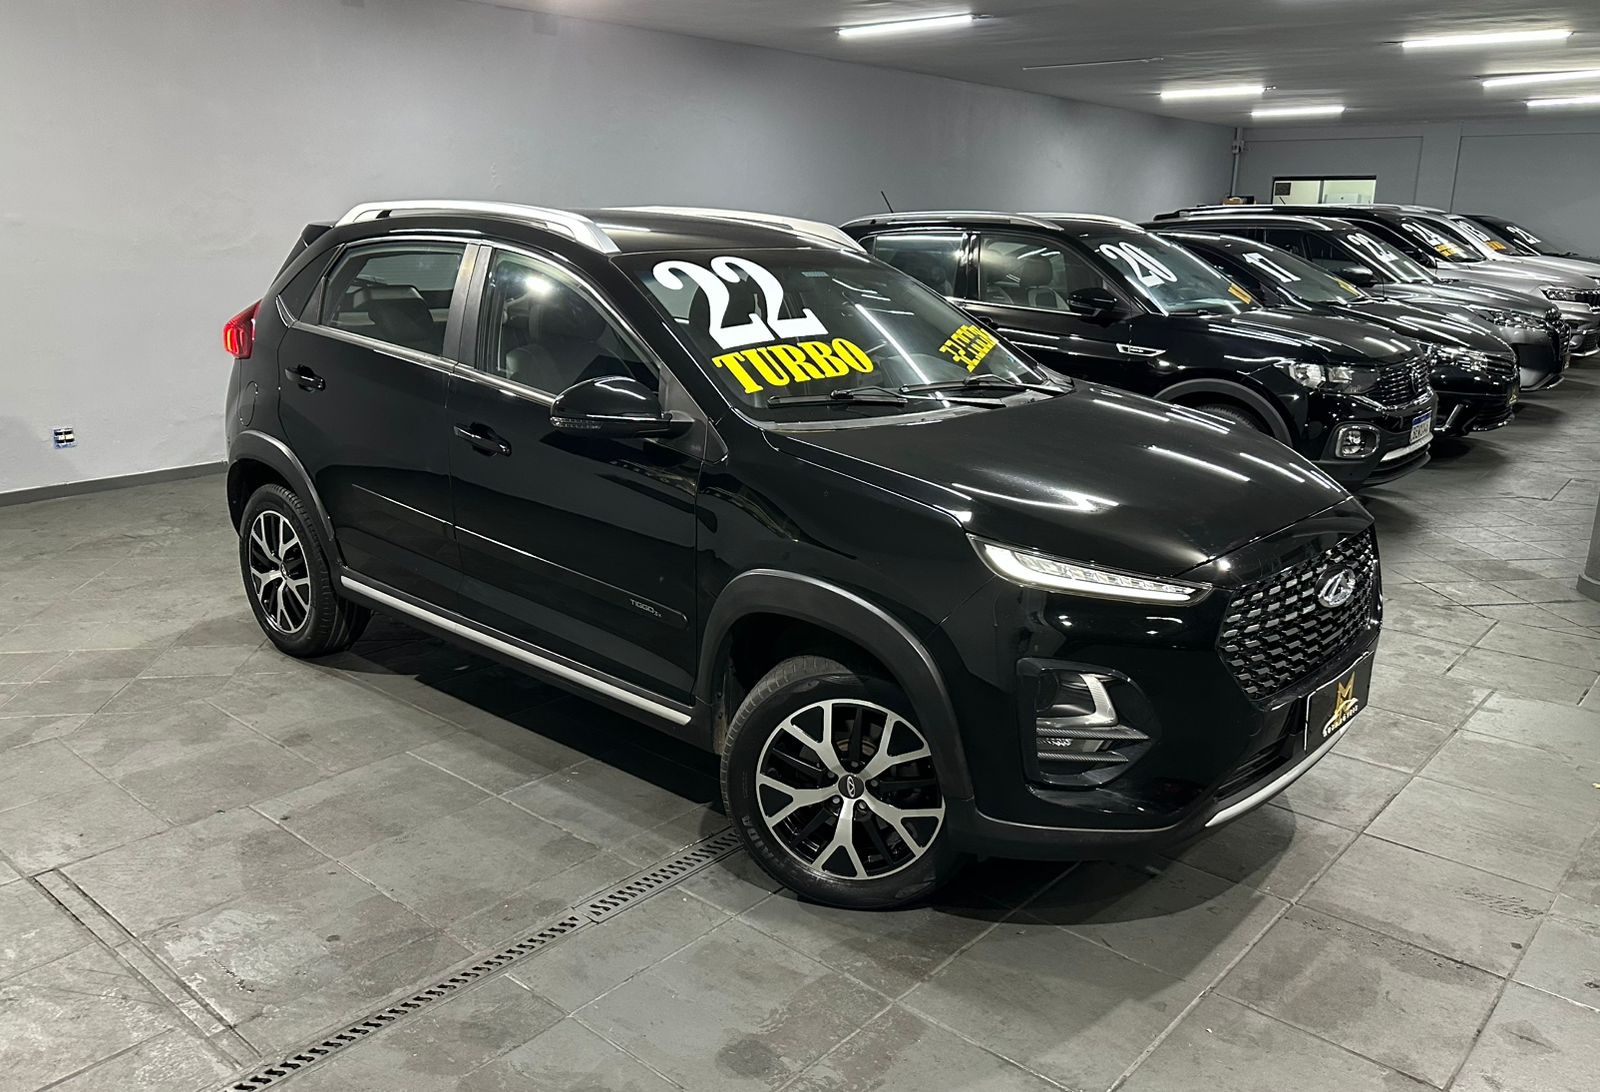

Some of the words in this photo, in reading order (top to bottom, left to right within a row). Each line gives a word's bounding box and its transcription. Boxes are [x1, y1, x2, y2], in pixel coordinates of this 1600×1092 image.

[1099, 242, 1178, 287] 20
[1242, 252, 1301, 283] 17
[1346, 233, 1399, 263] 22
[653, 256, 828, 350] 22
[711, 338, 874, 394] TURBO
